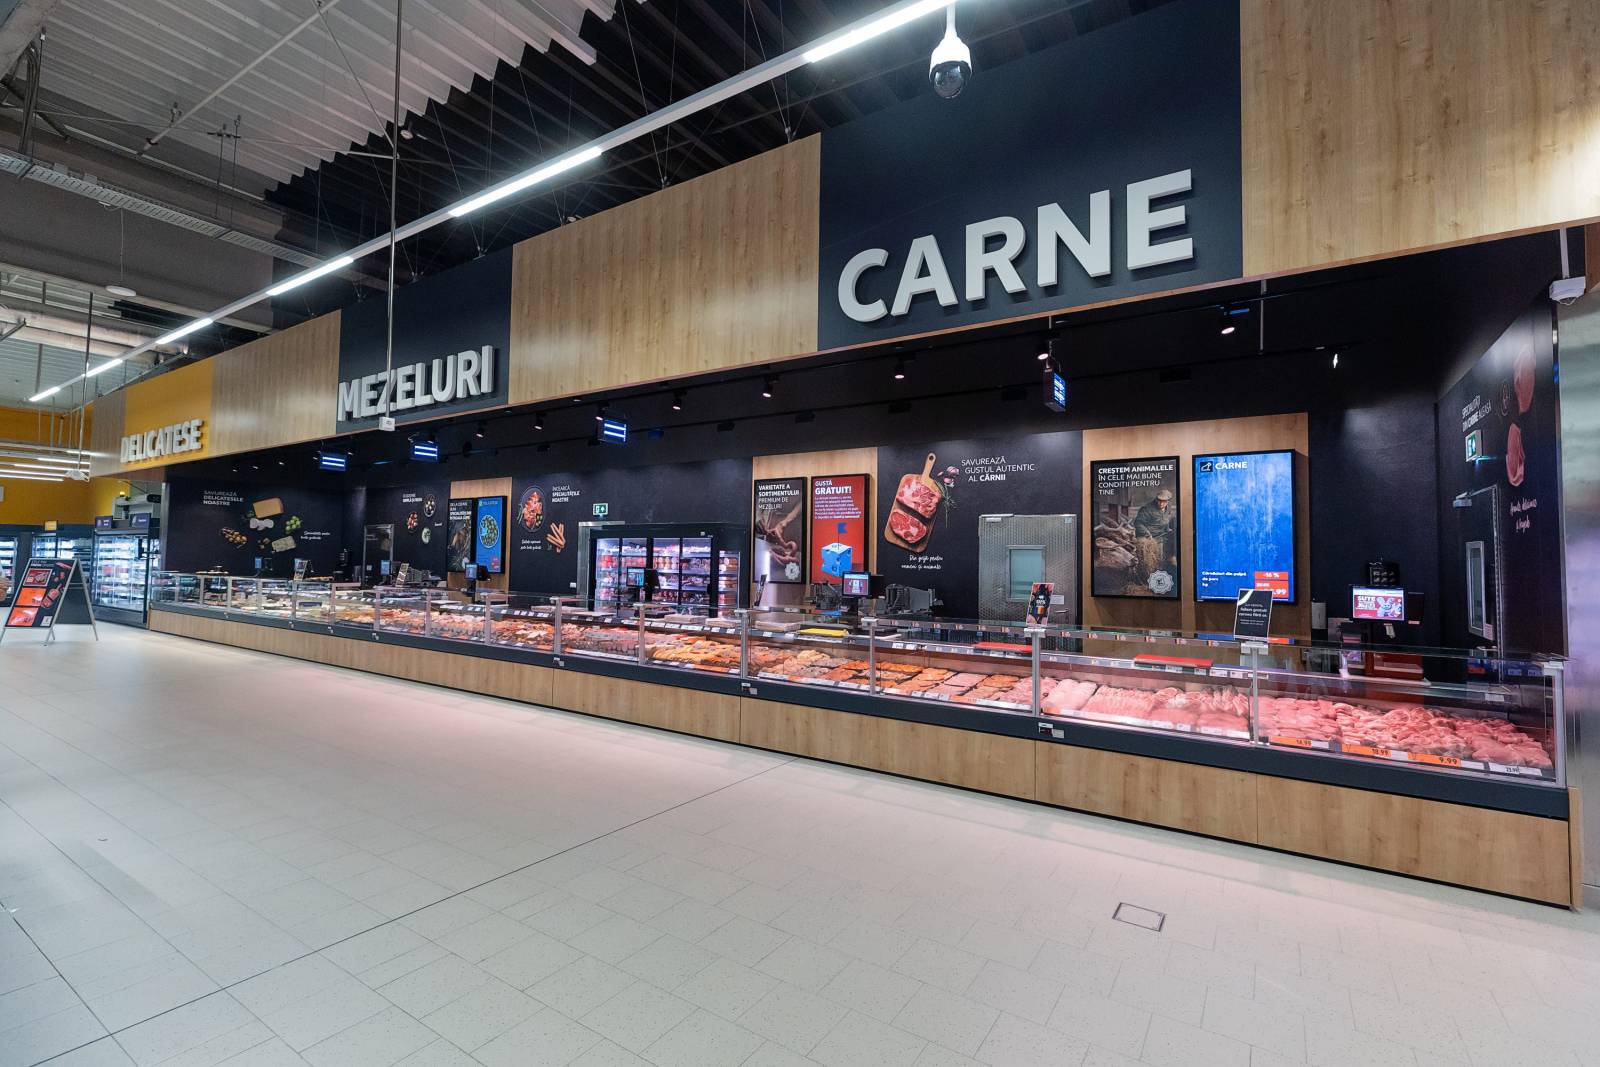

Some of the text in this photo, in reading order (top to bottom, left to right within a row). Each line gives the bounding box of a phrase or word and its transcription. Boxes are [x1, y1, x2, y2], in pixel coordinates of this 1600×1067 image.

[837, 168, 1194, 323] CARNE
[337, 344, 495, 422] MEZELURI
[120, 418, 204, 464] DELICATESE
[961, 455, 1006, 467] SAVUREAZĂ
[1214, 461, 1248, 470] CARNE
[964, 463, 1036, 474] GUSTUL AUTENTIC
[1098, 464, 1174, 475] CREȘTEM ANIMALELE
[979, 473, 1006, 481] CĂRNII
[1098, 472, 1162, 481] ÎN CELE MAI BUNE
[815, 479, 833, 487] GUSTĂ
[1098, 479, 1161, 489] CONDIȚII PENTRU
[758, 489, 800, 497] SORTIMENTULUI
[814, 485, 852, 495] GRATUIT!
[1439, 756, 1458, 765] 9.99
